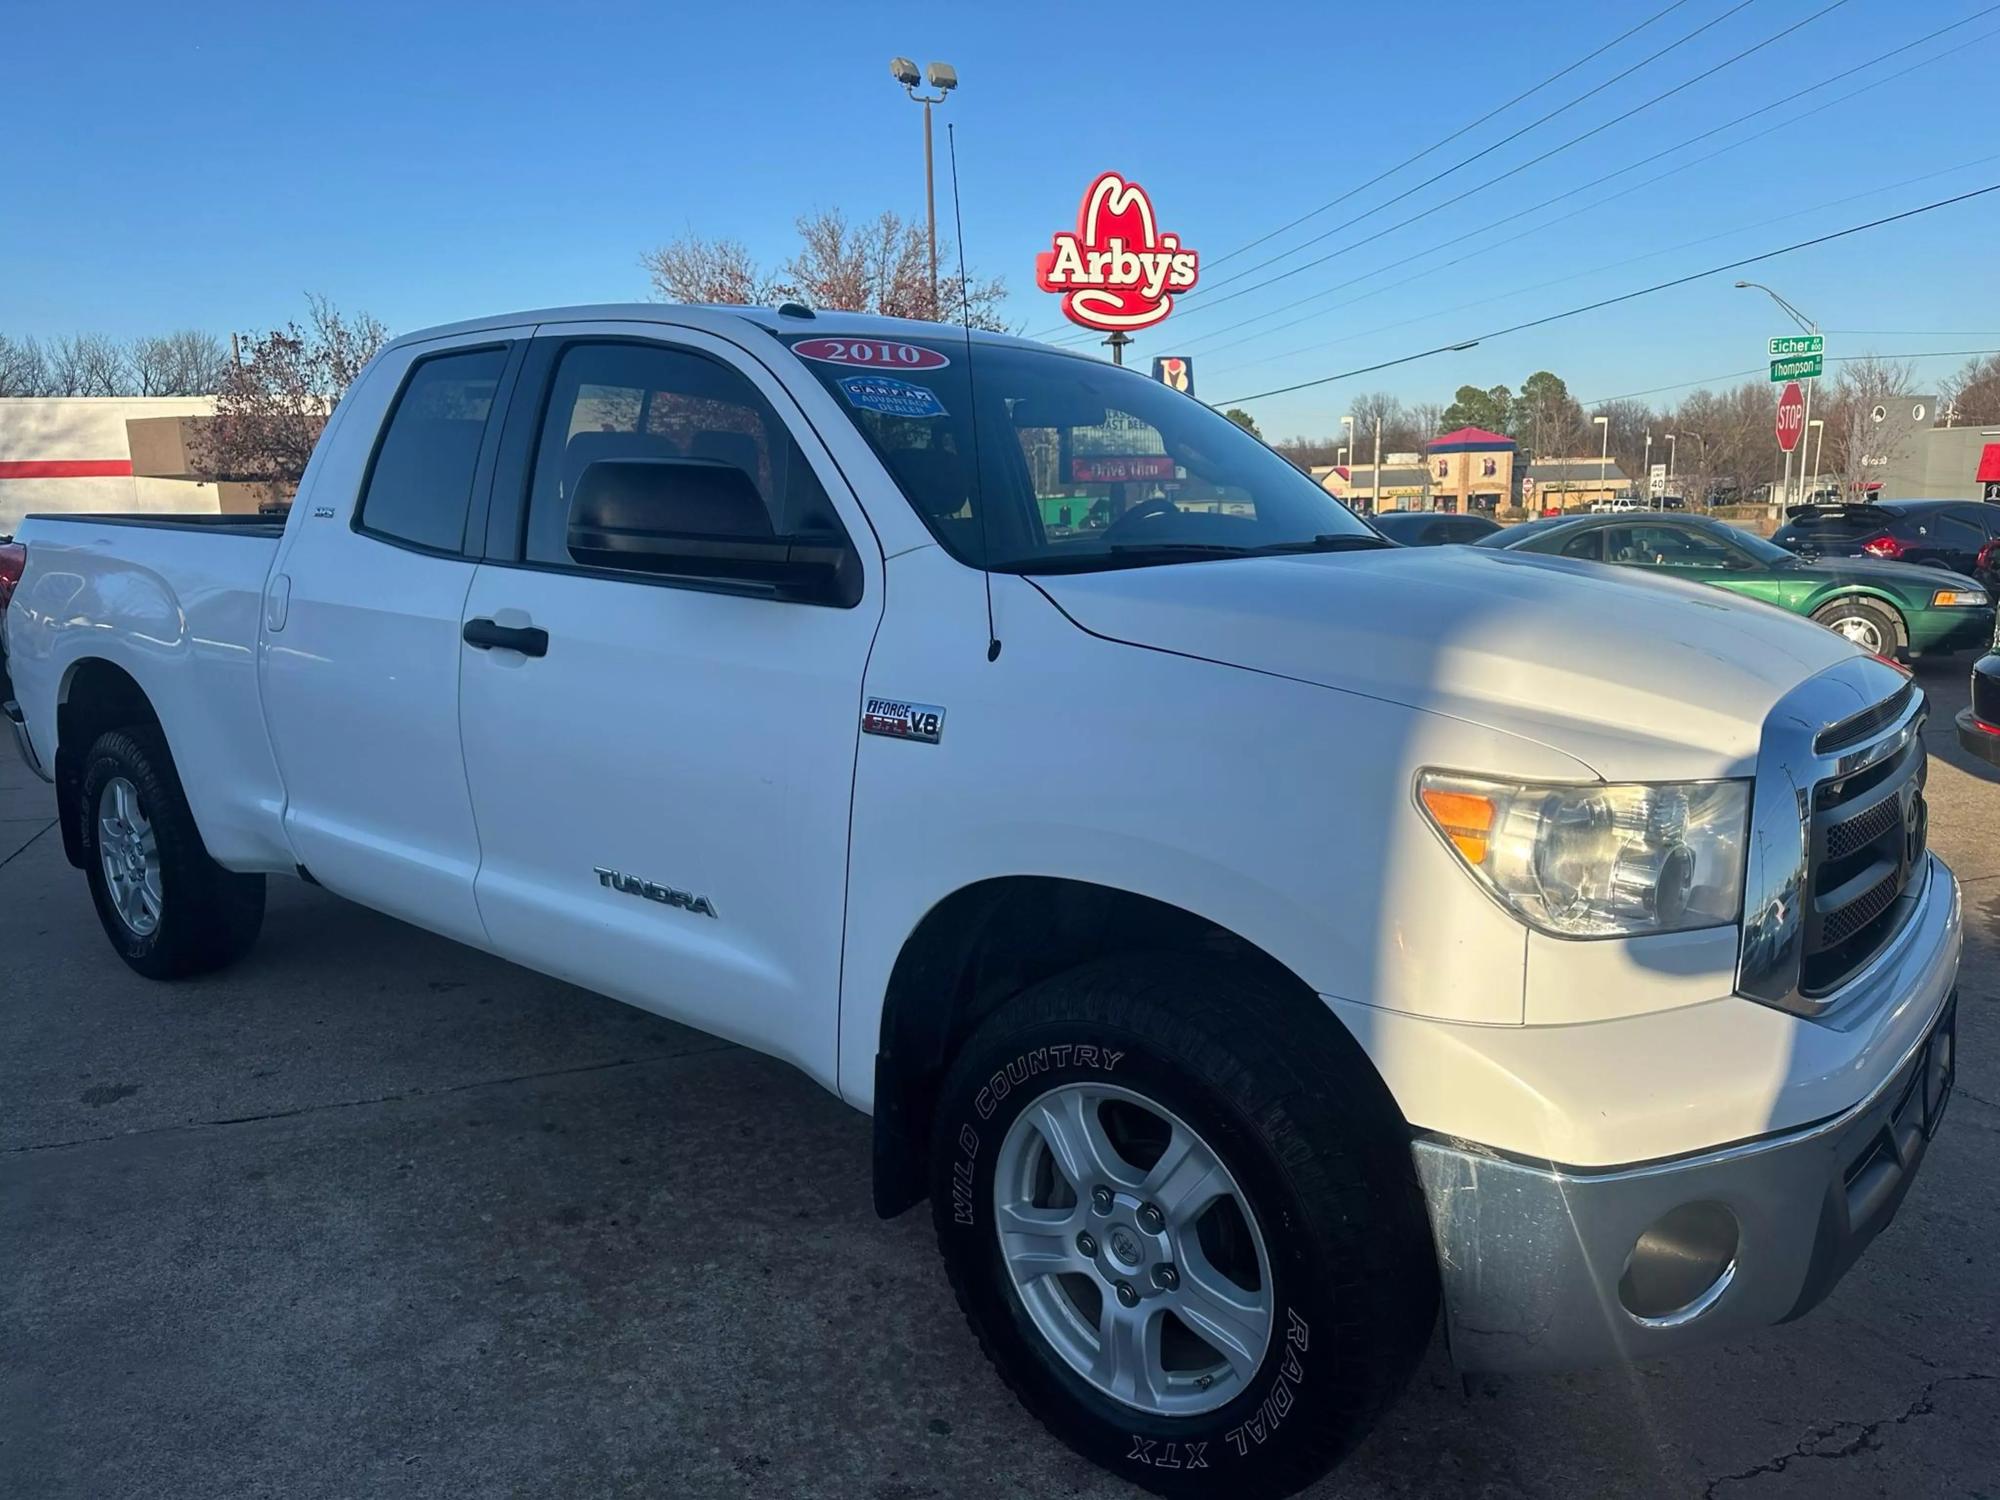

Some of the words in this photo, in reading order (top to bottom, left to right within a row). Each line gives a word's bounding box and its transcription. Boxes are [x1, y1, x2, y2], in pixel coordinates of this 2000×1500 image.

[1048, 237, 1195, 298] Arby's
[824, 342, 920, 364] 2010
[1771, 340, 1809, 352] Eicher
[1772, 361, 1814, 377] Thompson
[1778, 405, 1802, 430] STOP
[1092, 462, 1125, 477] Drive
[1651, 479, 1663, 488] 40
[911, 711, 938, 735] V8
[593, 866, 718, 919] TUNDRA
[953, 1123, 979, 1225] WILD
[975, 1044, 1125, 1120] COUNTRY
[1225, 1306, 1309, 1456] RADIAL
[1126, 1434, 1209, 1469] XTX
